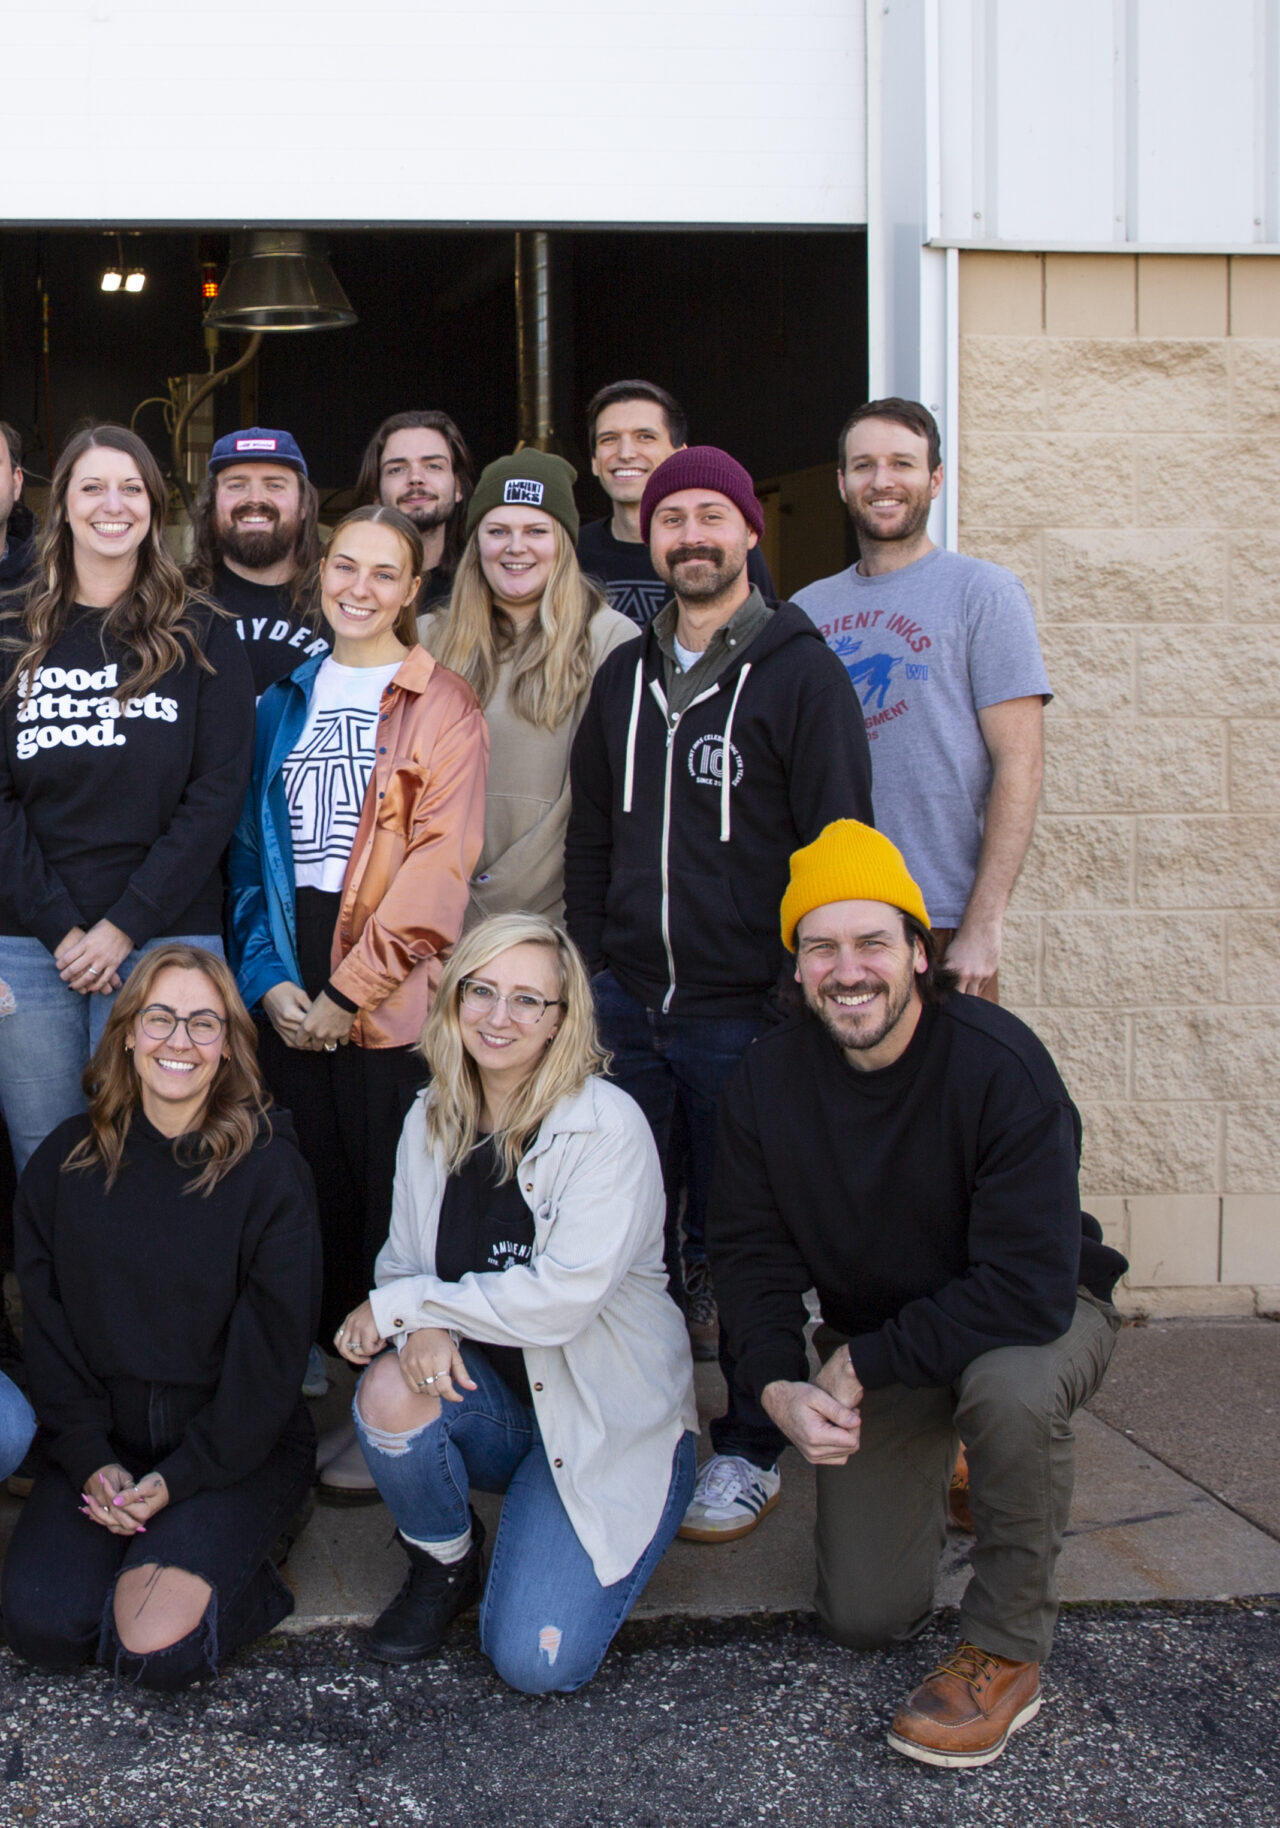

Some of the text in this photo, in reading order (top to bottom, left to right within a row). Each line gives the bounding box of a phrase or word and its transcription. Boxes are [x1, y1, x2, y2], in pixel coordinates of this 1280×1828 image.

[506, 488, 540, 503] INKS
[885, 612, 932, 653] INKS
[17, 663, 118, 698] good
[905, 663, 929, 681] WI
[17, 692, 179, 723] attracts
[16, 719, 126, 760] good.
